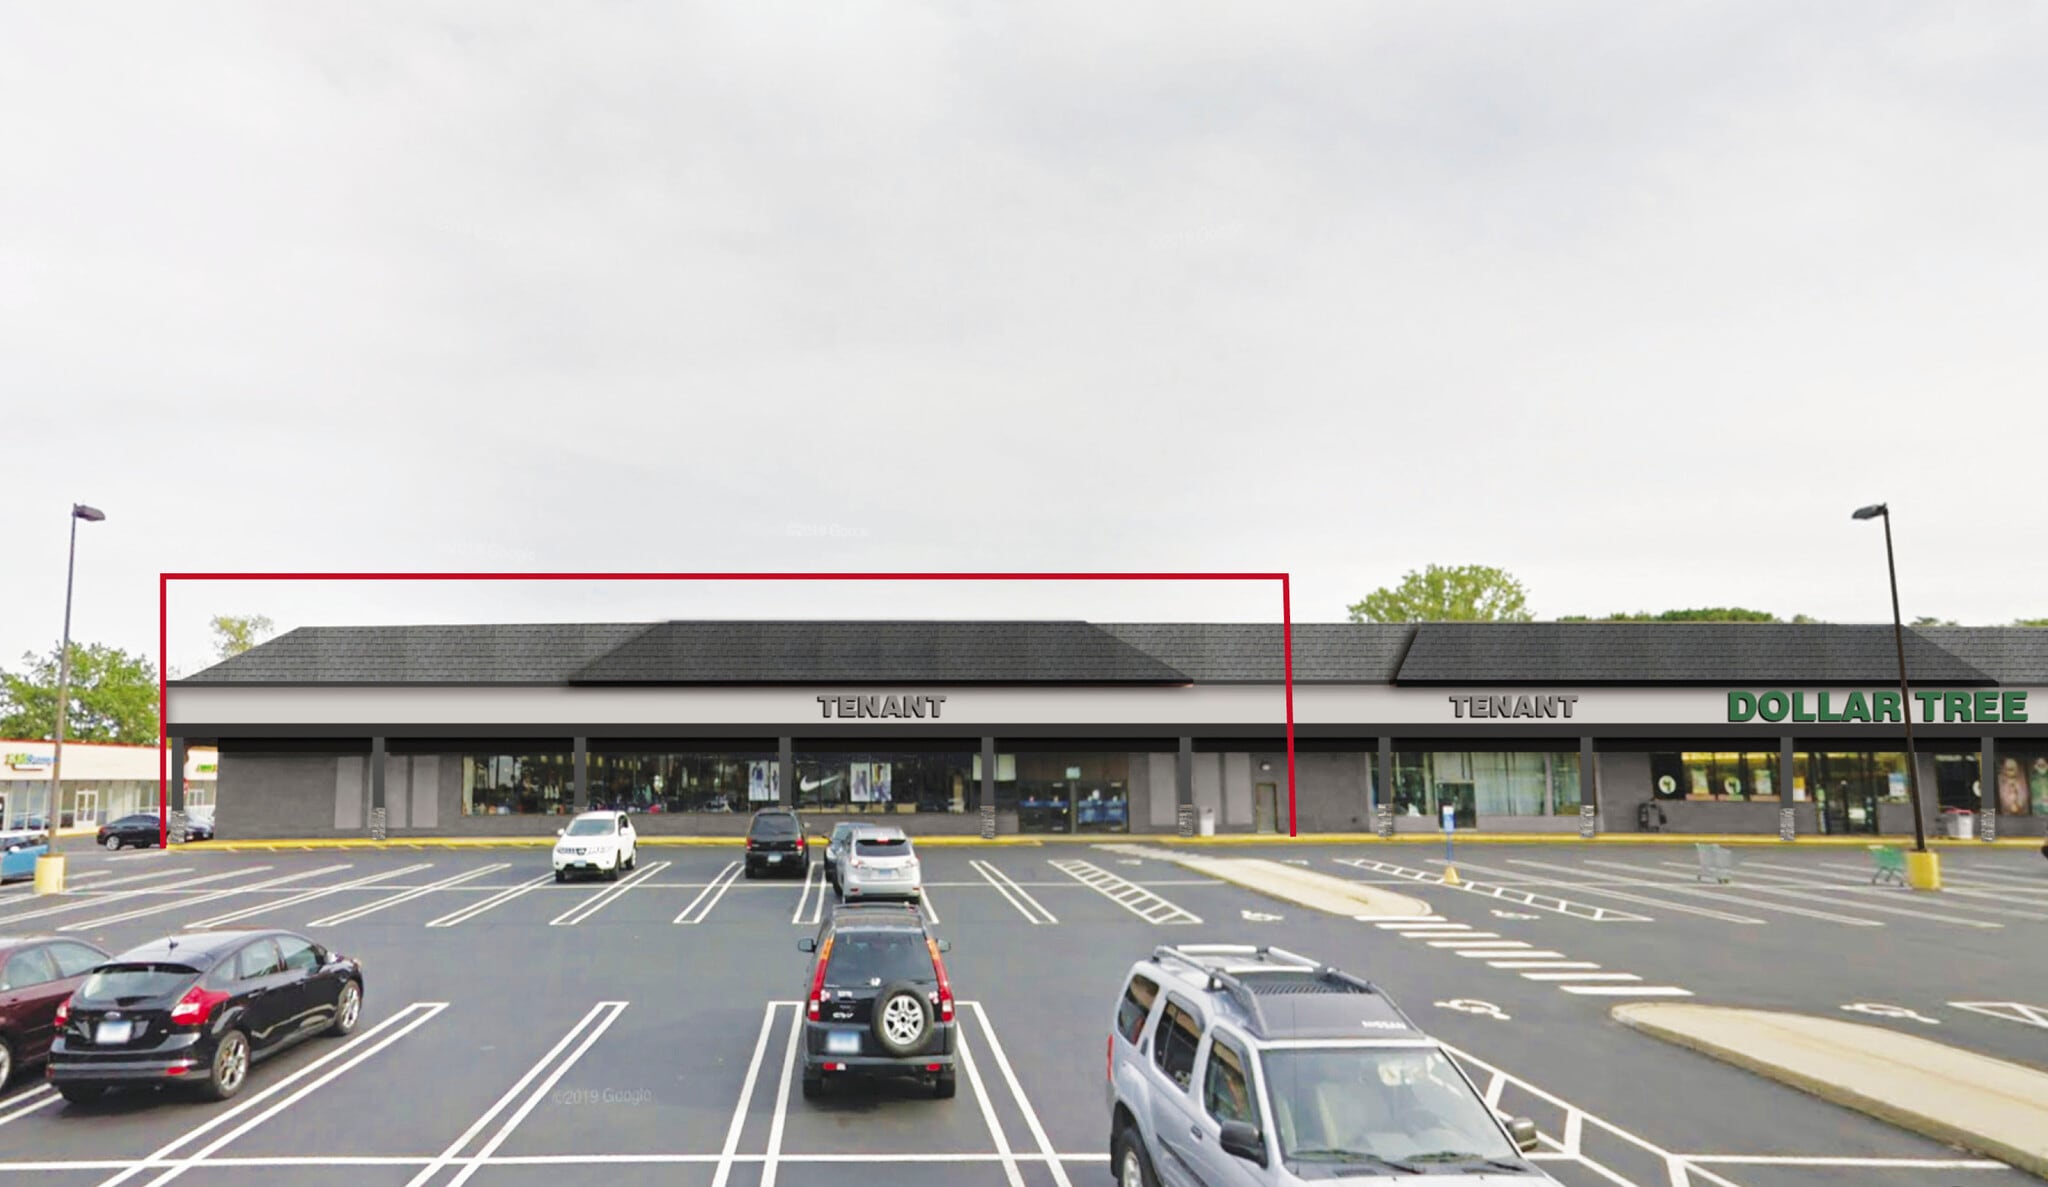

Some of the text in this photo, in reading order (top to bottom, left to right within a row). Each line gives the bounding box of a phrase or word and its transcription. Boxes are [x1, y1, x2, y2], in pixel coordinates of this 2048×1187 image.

[817, 695, 947, 718] TENANT
[1449, 695, 1579, 718] TENANT
[1727, 690, 2028, 722] DOLLAR TREE
